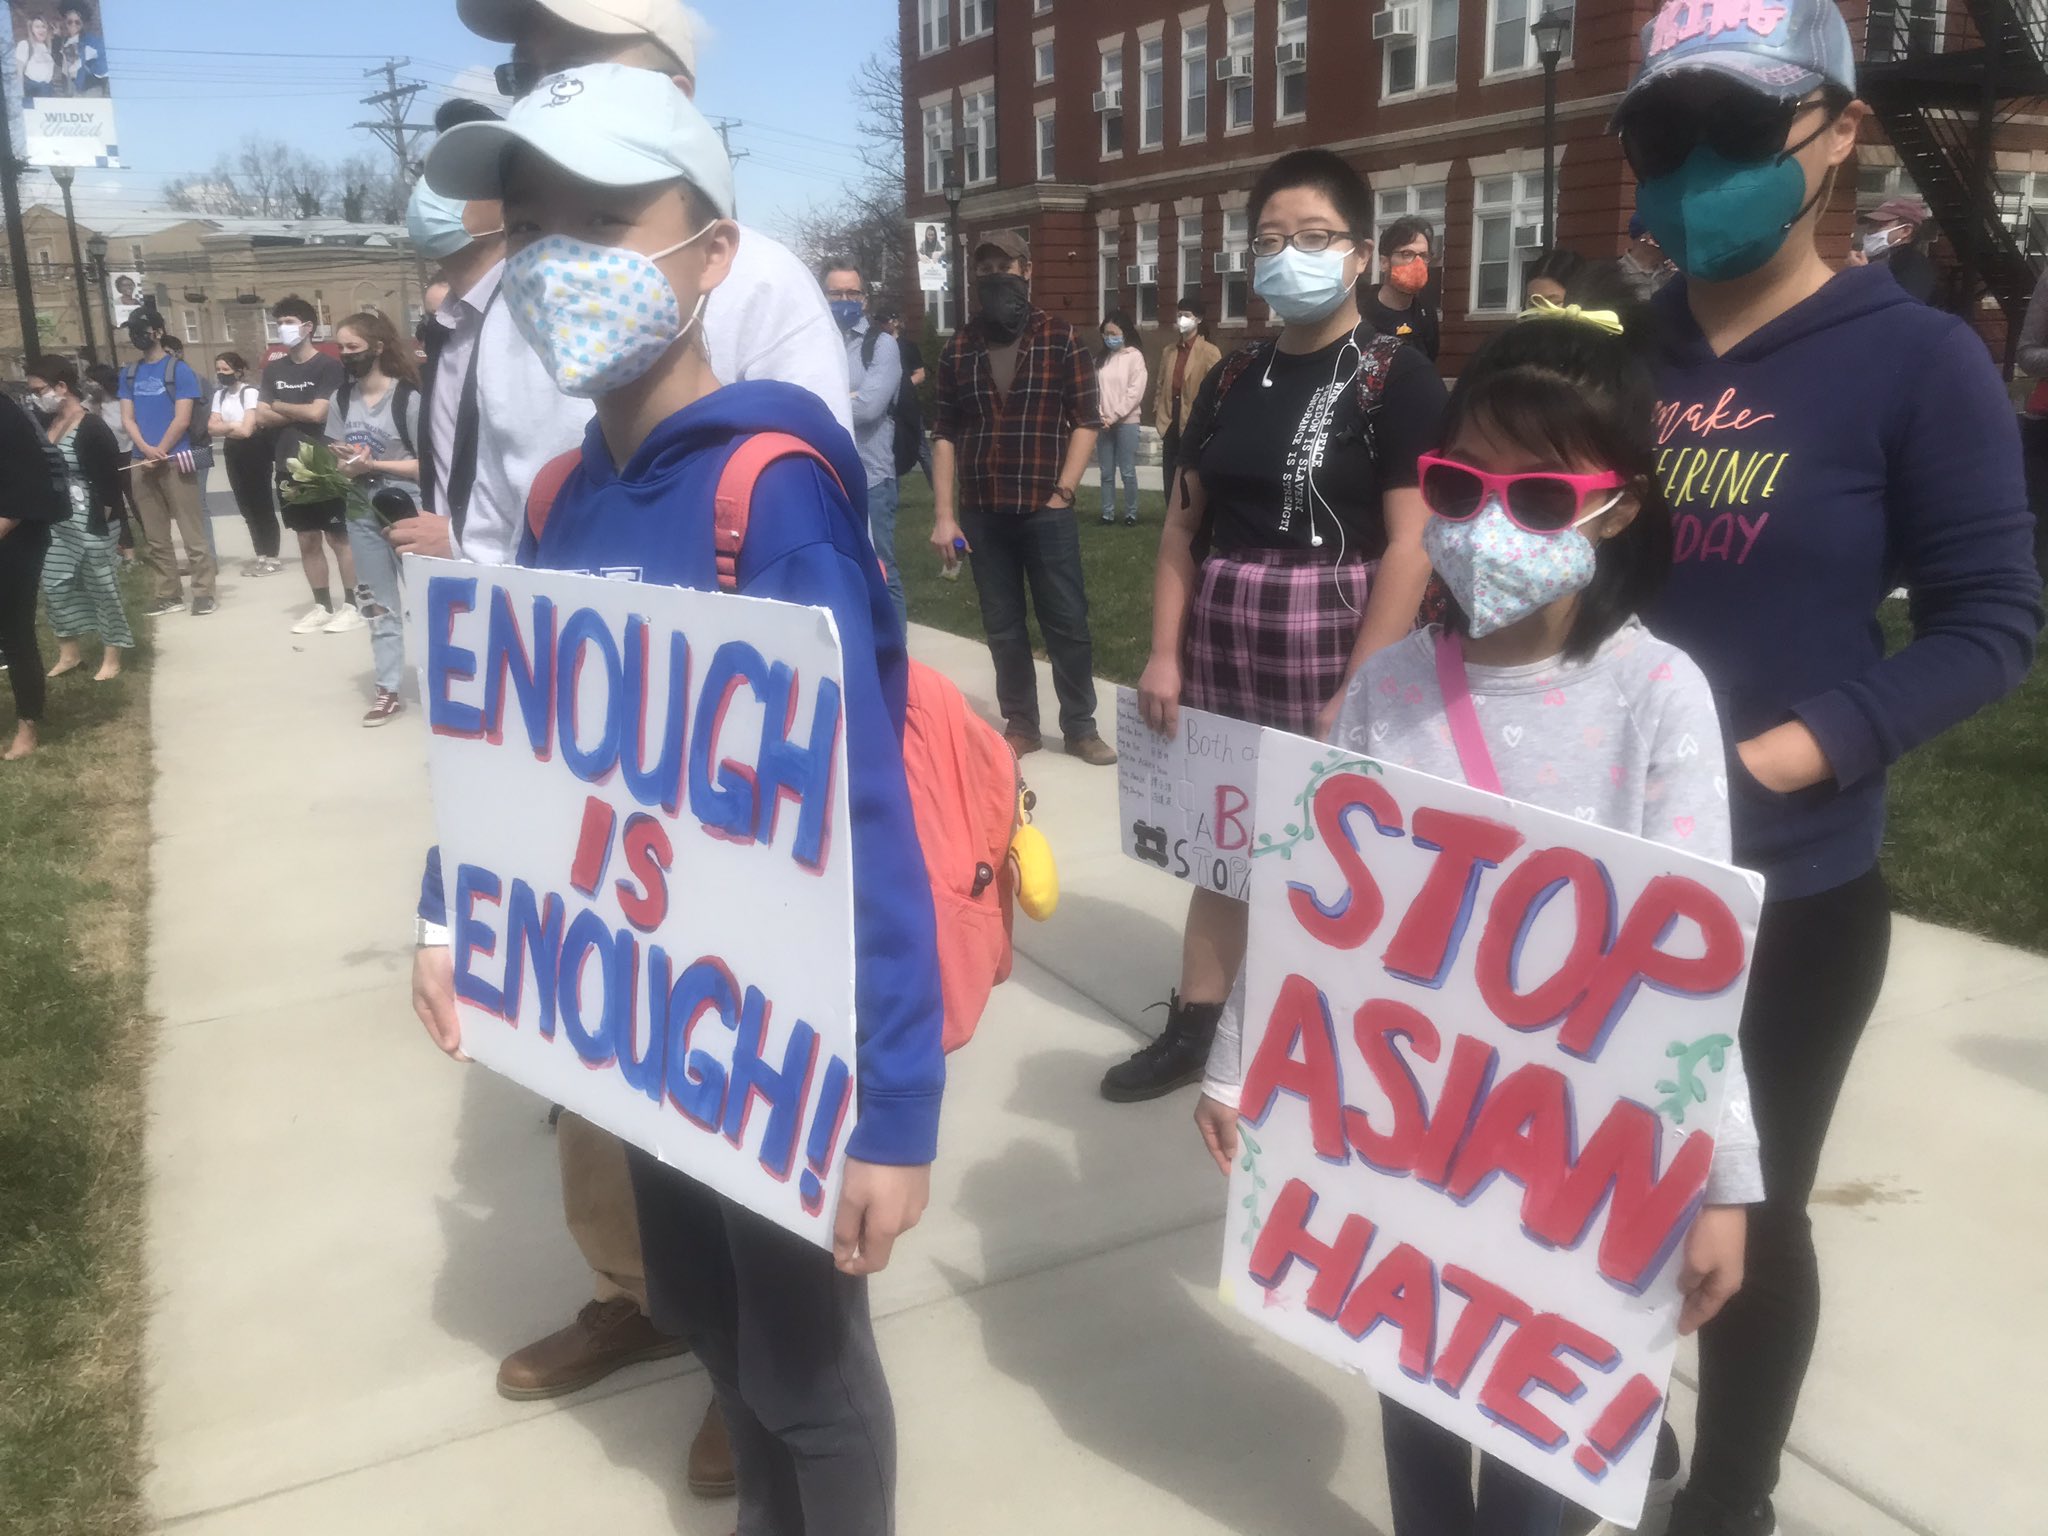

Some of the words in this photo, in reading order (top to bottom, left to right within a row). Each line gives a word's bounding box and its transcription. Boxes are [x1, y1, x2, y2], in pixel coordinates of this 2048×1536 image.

[41, 121, 103, 137] United
[44, 112, 94, 122] WILDLY
[1292, 386, 1324, 445] IGNORANCE
[1308, 383, 1332, 433] FREEDOM
[1323, 411, 1334, 425] IS
[1286, 451, 1298, 466] IS
[1302, 438, 1314, 452] IS
[1312, 432, 1329, 468] PEACE
[1294, 458, 1308, 512] SLAVERY
[1671, 512, 1770, 565] DAY
[428, 576, 841, 876] ENOUGH
[1187, 718, 1234, 764] Both
[571, 796, 674, 933] IS
[1287, 772, 1745, 1063] STOP
[454, 864, 853, 1217] ENOUGH!
[1238, 973, 1715, 1296] ASIAN
[1248, 1178, 1664, 1484] HATE!
